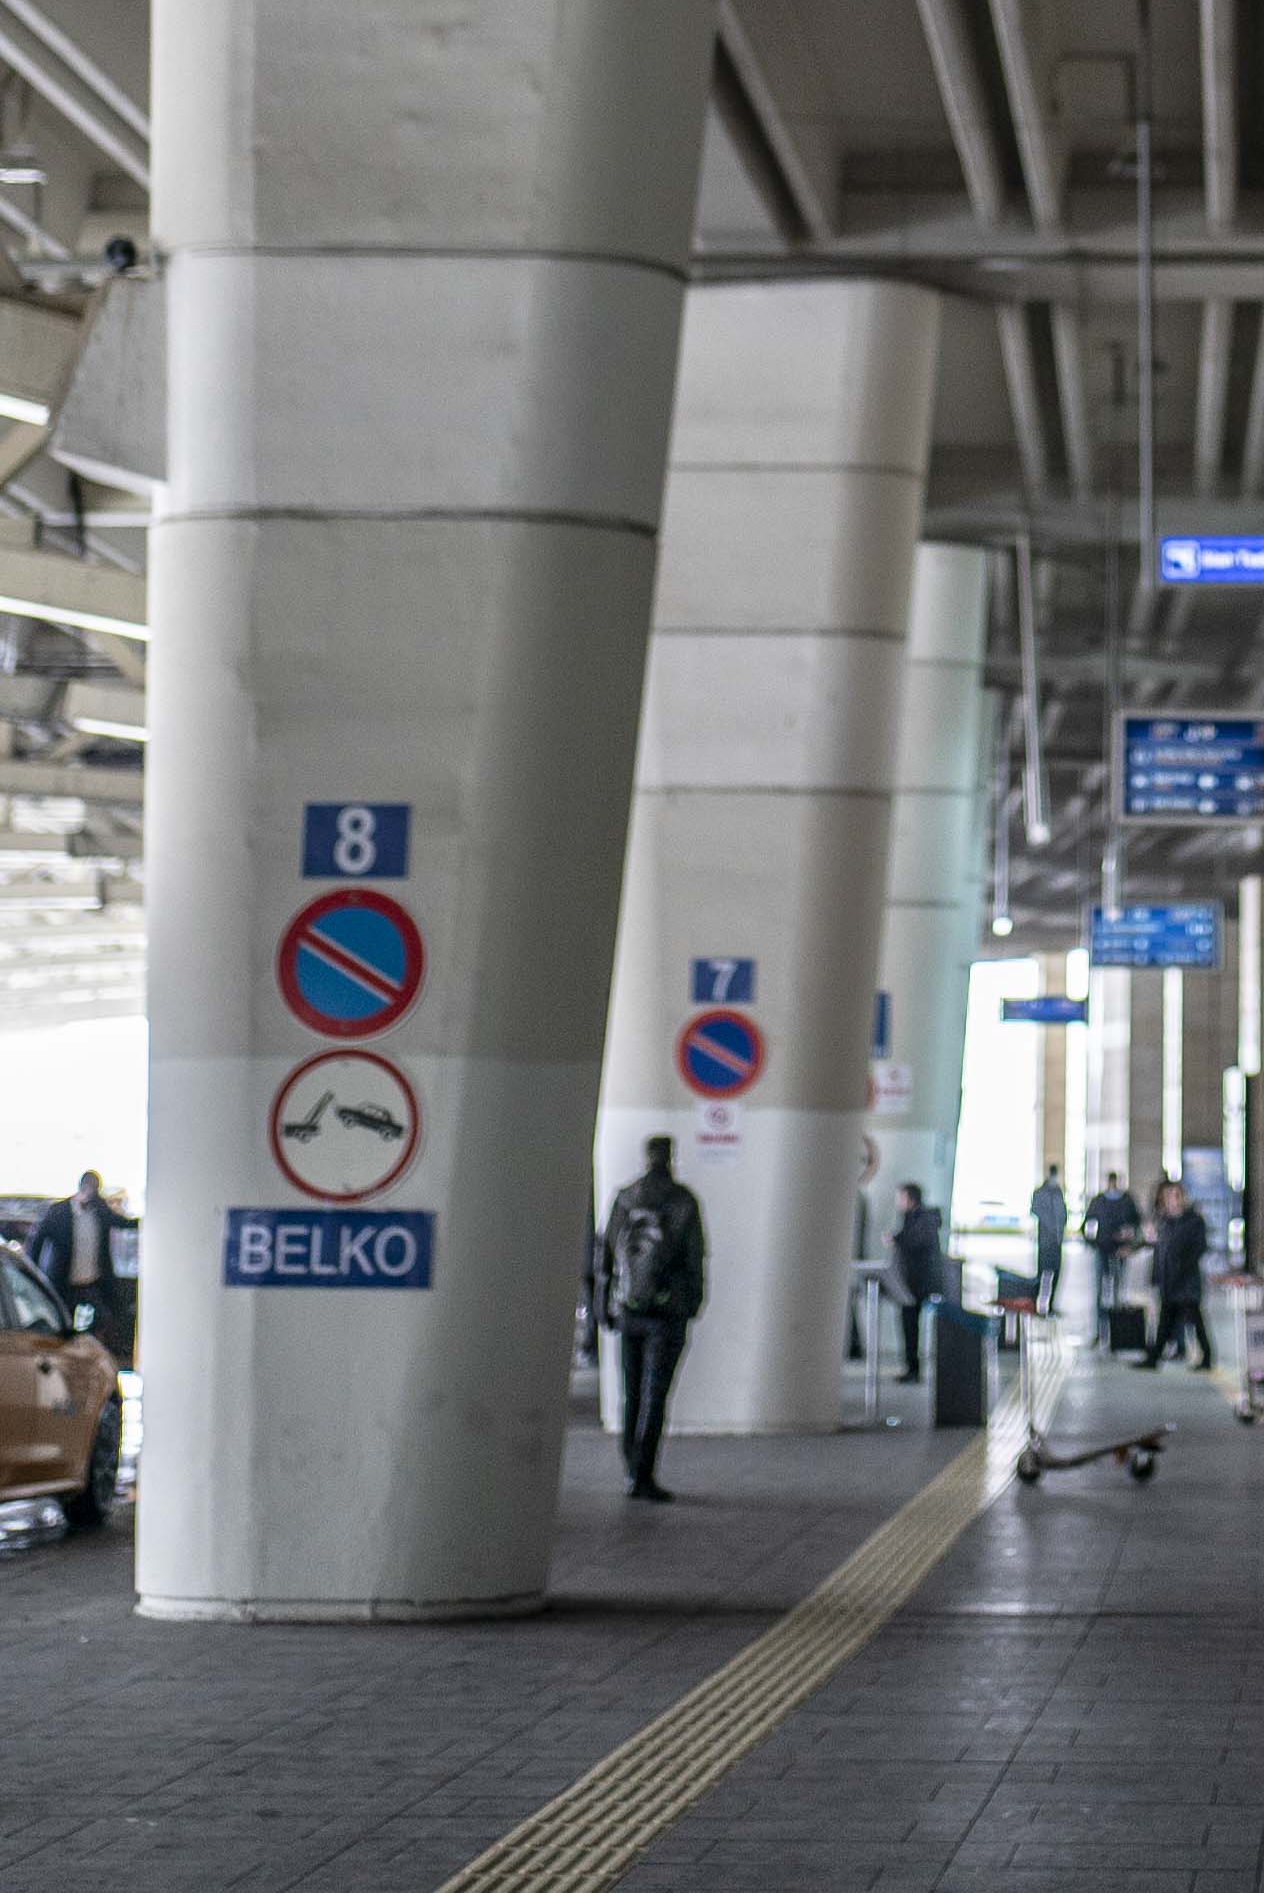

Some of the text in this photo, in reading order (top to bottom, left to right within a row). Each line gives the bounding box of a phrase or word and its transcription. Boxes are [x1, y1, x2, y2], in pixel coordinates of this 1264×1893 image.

[334, 807, 376, 875] 8
[708, 960, 739, 1001] 7
[238, 1225, 418, 1275] BELKO
